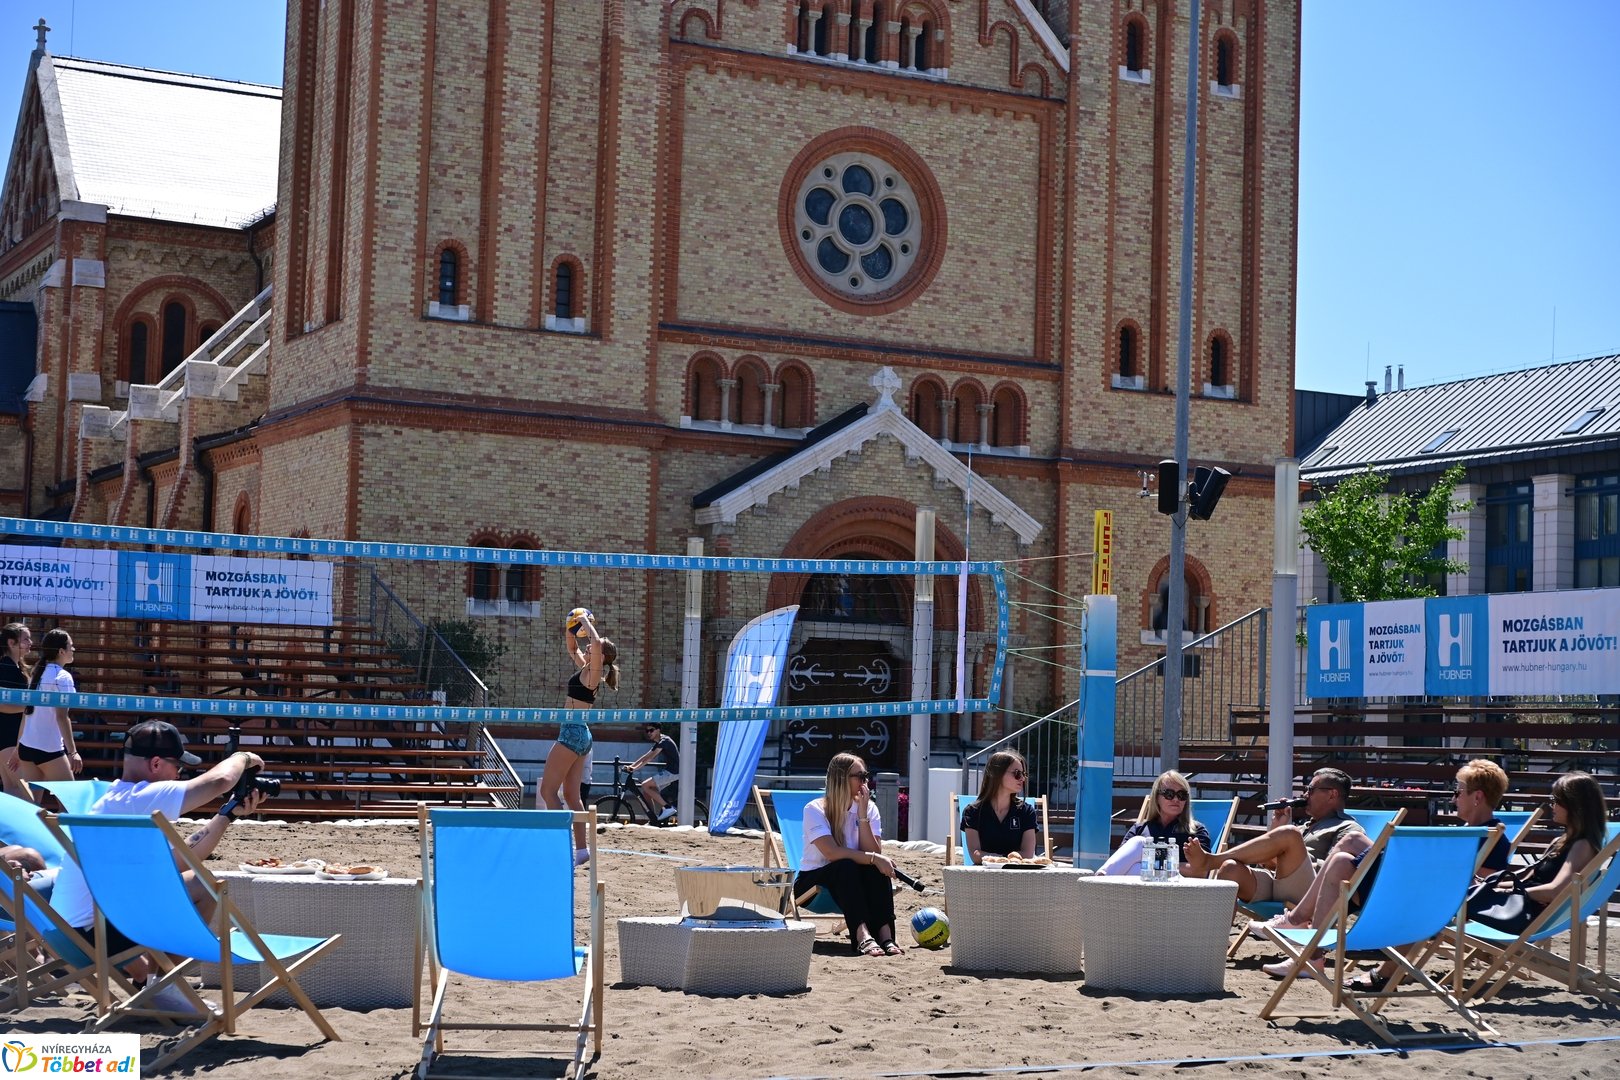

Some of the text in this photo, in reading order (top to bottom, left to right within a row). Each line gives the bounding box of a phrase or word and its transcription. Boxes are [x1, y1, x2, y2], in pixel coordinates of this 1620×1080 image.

[45, 578, 54, 588] A
[205, 571, 287, 584] MOZGÁSBAN
[205, 586, 260, 598] TARTJUK
[262, 588, 272, 599] A
[1369, 623, 1421, 636] MOZGÁSBAN
[1502, 615, 1584, 633] MOZGÁSBAN
[1368, 639, 1404, 650] TARTJUK
[1502, 638, 1558, 653] TARTJUK
[1559, 637, 1569, 652] A
[1369, 654, 1376, 664] A
